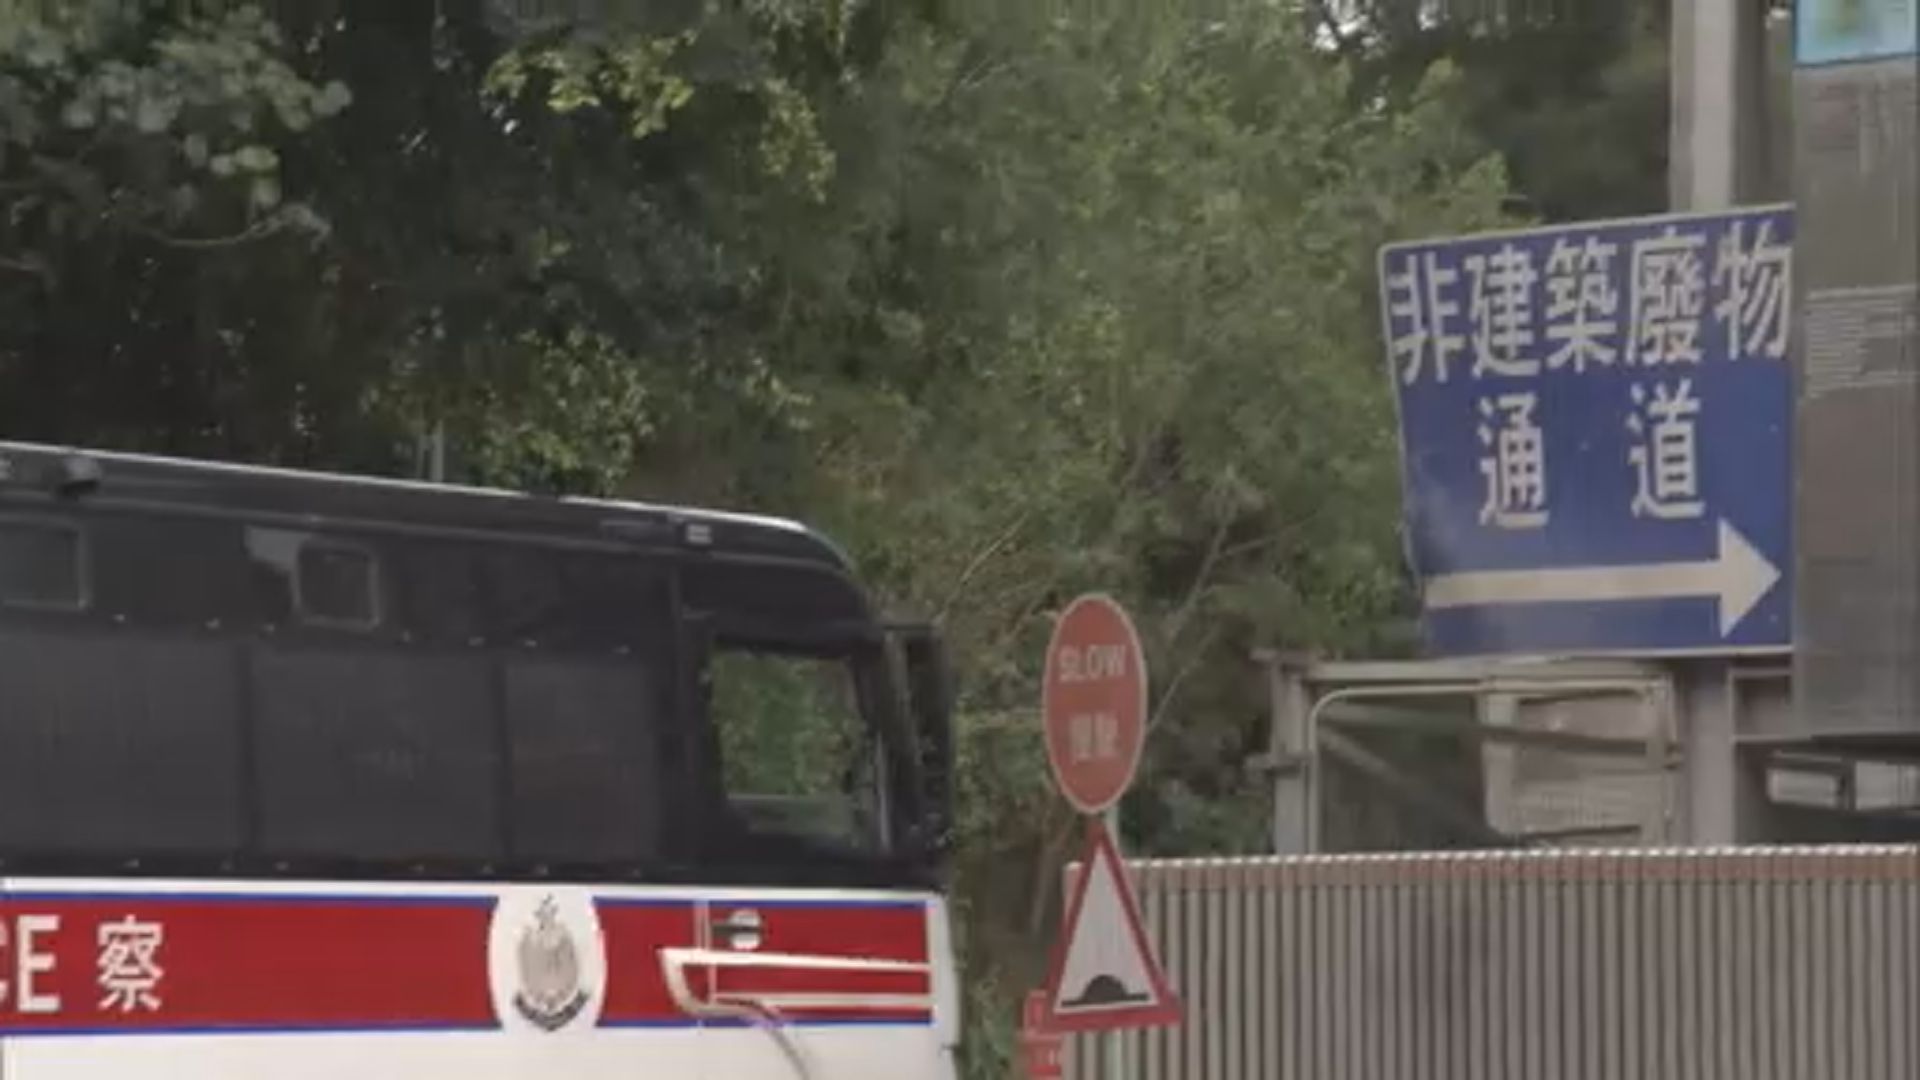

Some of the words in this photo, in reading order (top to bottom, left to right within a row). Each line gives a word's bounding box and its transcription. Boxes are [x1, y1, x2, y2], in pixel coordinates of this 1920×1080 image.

[1388, 220, 1793, 384] 非建築廢物
[1059, 644, 1126, 682] SLOW
[0, 914, 61, 1012] E
[97, 913, 164, 1012] 察
